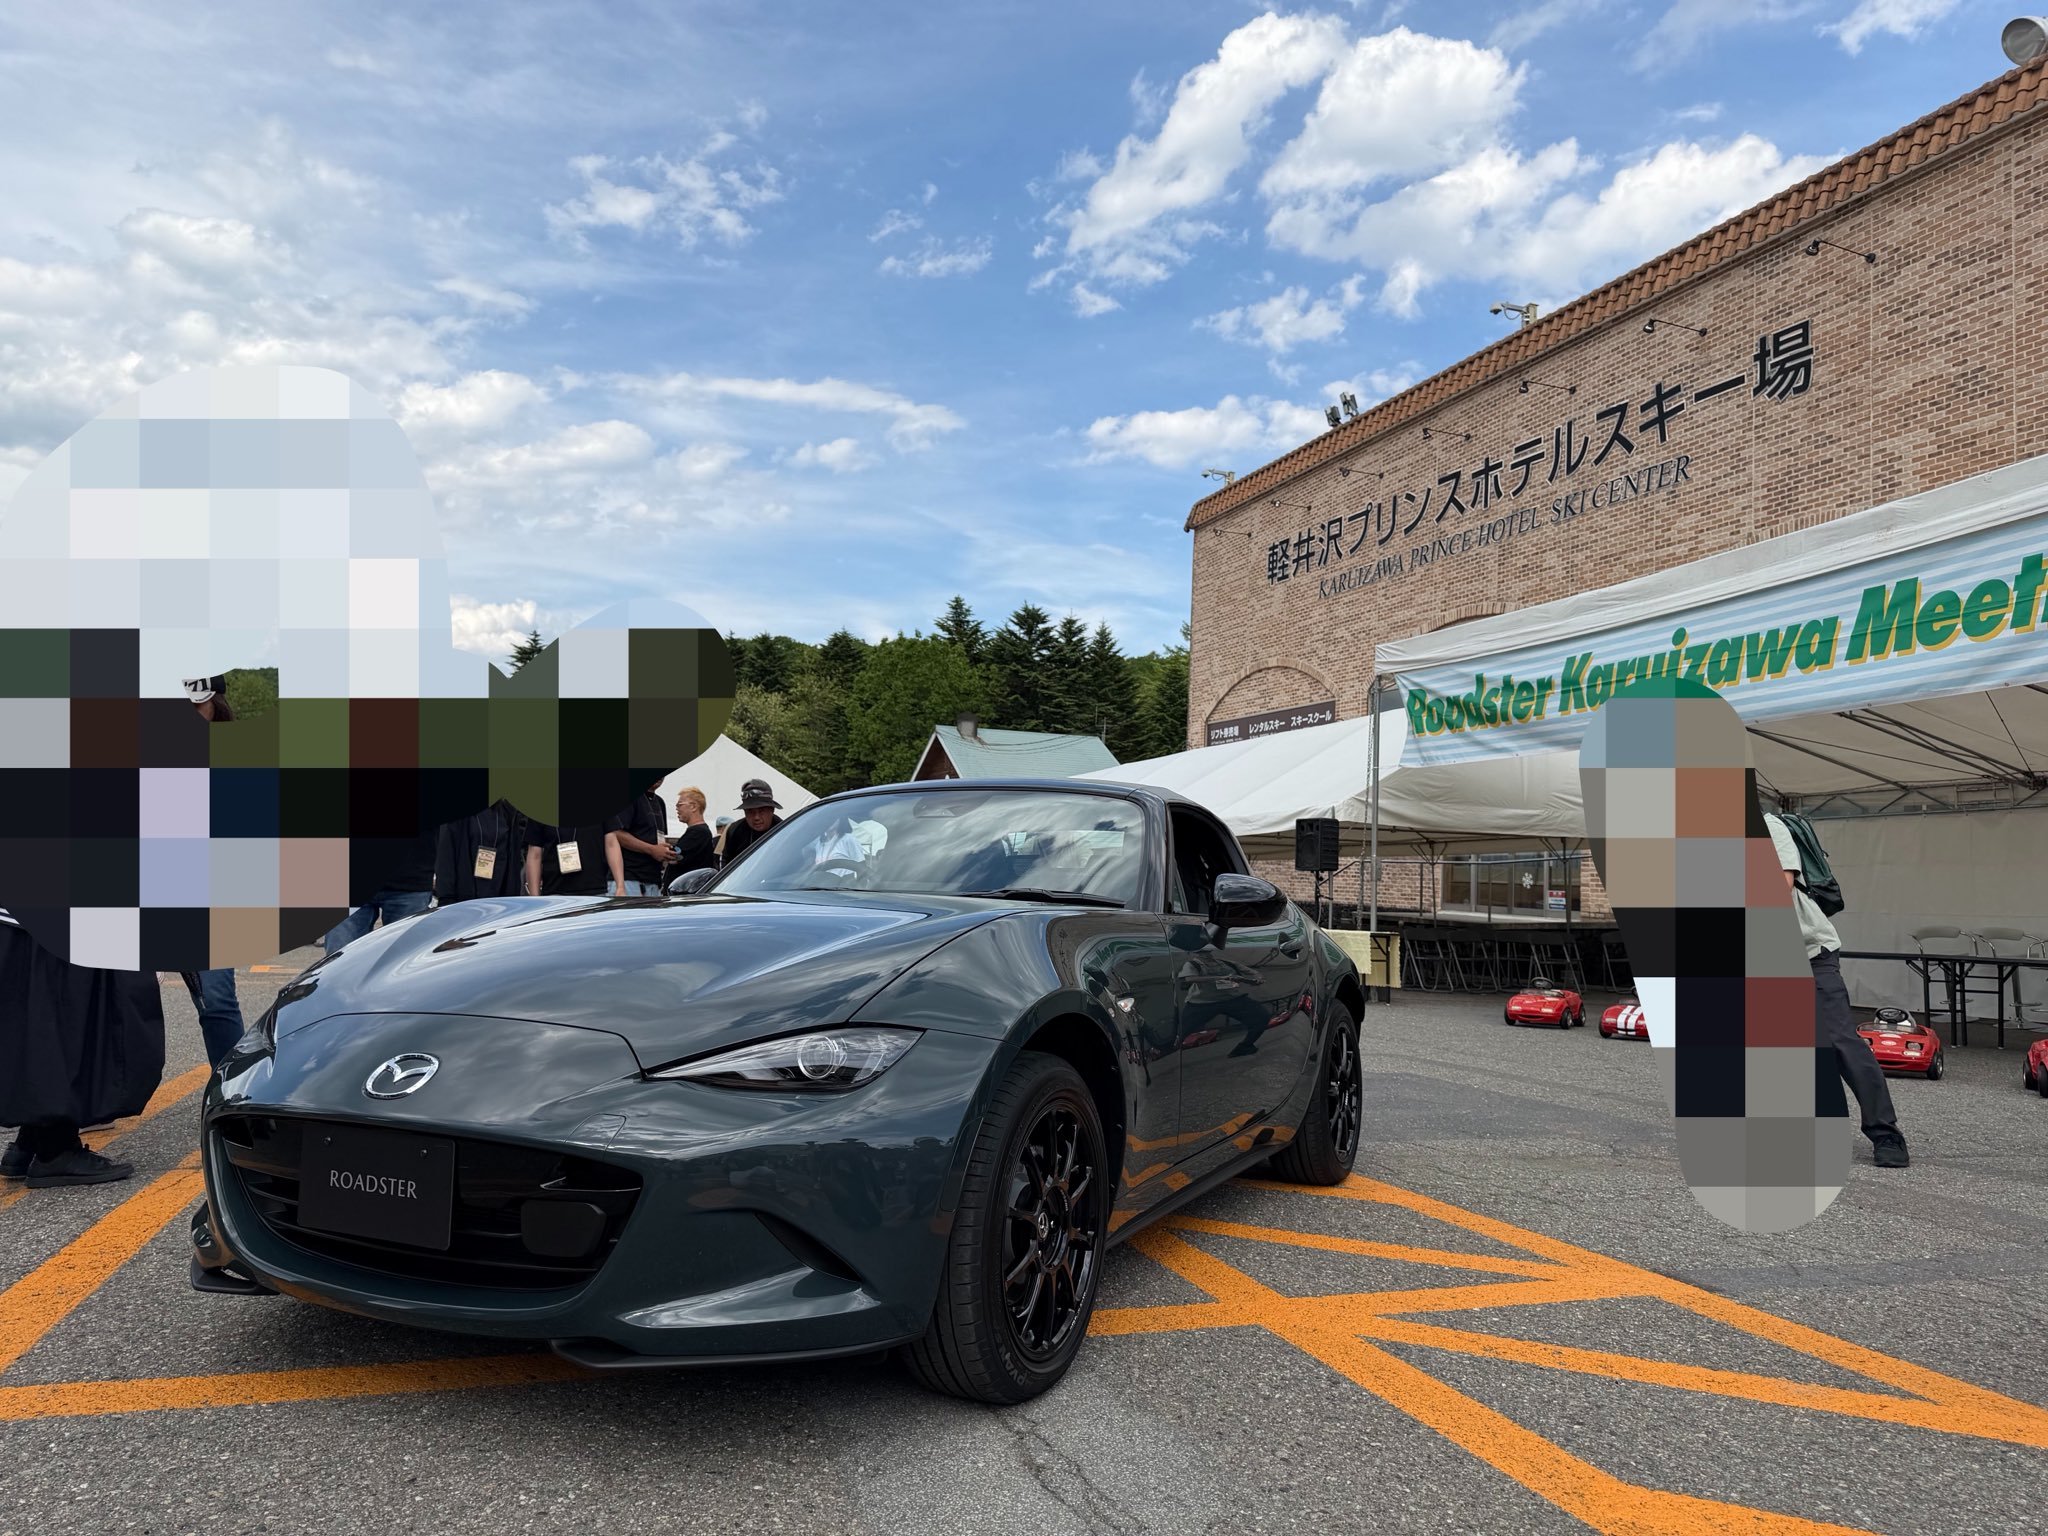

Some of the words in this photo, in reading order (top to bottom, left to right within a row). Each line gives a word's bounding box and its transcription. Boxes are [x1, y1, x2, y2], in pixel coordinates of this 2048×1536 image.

[1267, 319, 1814, 585] 軽井沢プリンスホテルスキー場
[1318, 555, 1404, 599] KARUIZAWA
[1409, 528, 1474, 571] PRINCE
[1478, 506, 1543, 547] HOTEL
[1550, 488, 1587, 523] SKI
[1592, 454, 1694, 508] CENTER
[1407, 672, 1555, 738] Roadster
[1844, 552, 2048, 667] Meet
[1248, 719, 1286, 734] レンタルスキー
[1290, 710, 1333, 727] スキースクール
[329, 1169, 418, 1200] ROADSTER
